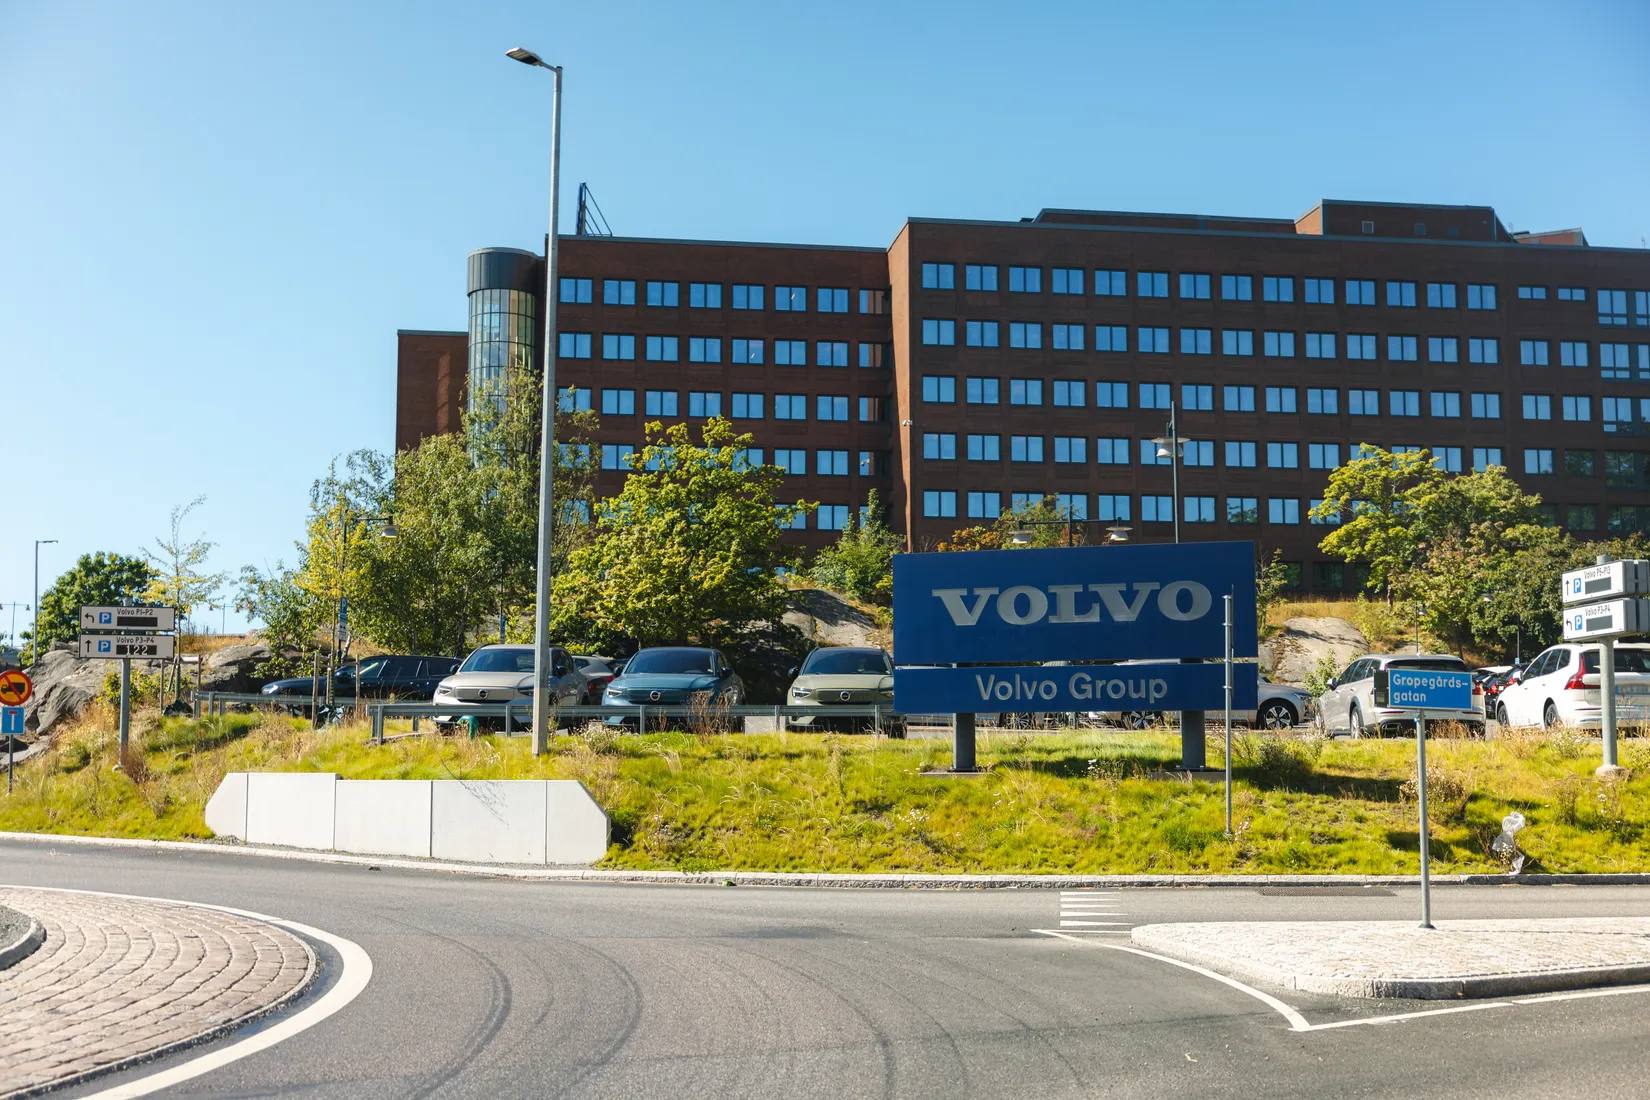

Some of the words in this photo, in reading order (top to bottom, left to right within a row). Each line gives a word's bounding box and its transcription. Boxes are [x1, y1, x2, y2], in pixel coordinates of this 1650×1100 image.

[1584, 570, 1595, 579] Volvo
[1596, 566, 1611, 576] P5-P13
[931, 580, 1212, 626] VOLVO
[1585, 608, 1596, 617] Volvo
[1597, 604, 1610, 614] P3-P4
[101, 613, 110, 623] P
[100, 642, 109, 651] P
[126, 645, 148, 655] 122
[1392, 673, 1468, 689] Gropegårds-
[975, 673, 1057, 701] Volvo
[1068, 672, 1168, 704] Group
[1393, 691, 1427, 704] gatan
